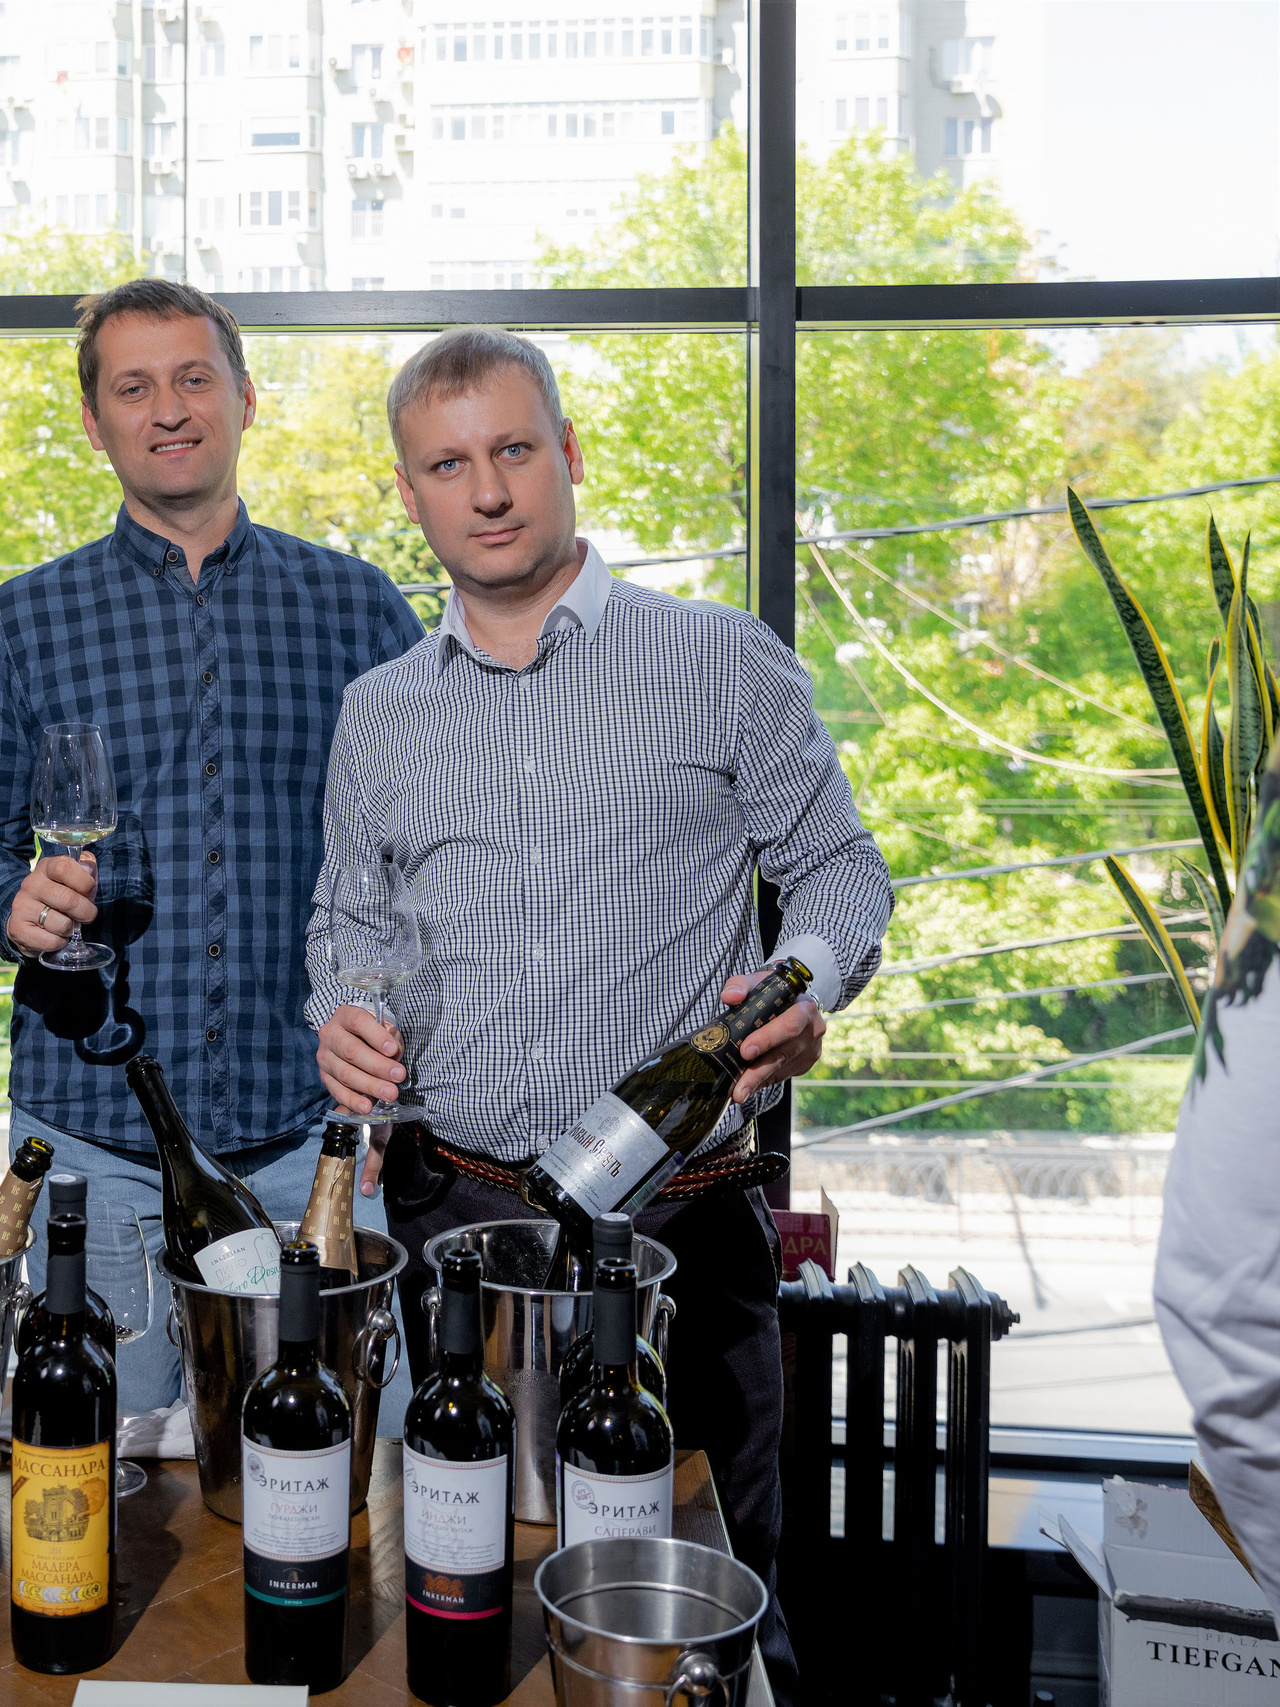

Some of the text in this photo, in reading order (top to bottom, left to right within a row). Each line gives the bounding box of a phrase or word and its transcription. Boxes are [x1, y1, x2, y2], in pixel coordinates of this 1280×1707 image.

[783, 1236, 827, 1256] ДРА
[215, 1258, 247, 1279] ПИНО
[14, 1456, 105, 1478] МАССАНДРА
[259, 1474, 329, 1492] ЭРИТАЖ
[412, 1480, 480, 1504] ЭРИТАЖ
[270, 1502, 318, 1515] ГУРДЖИ
[421, 1508, 466, 1525] ИНДЖИ
[588, 1500, 660, 1518] ЭРИТАЖ
[594, 1524, 656, 1537] САПЕРАВИ
[31, 1559, 80, 1572] МАДЕРА
[21, 1568, 94, 1584] МАССАНДРА
[269, 1579, 318, 1590] INKERMAN
[422, 1589, 465, 1604] INKERMAN
[1205, 1633, 1259, 1648] PFALZ
